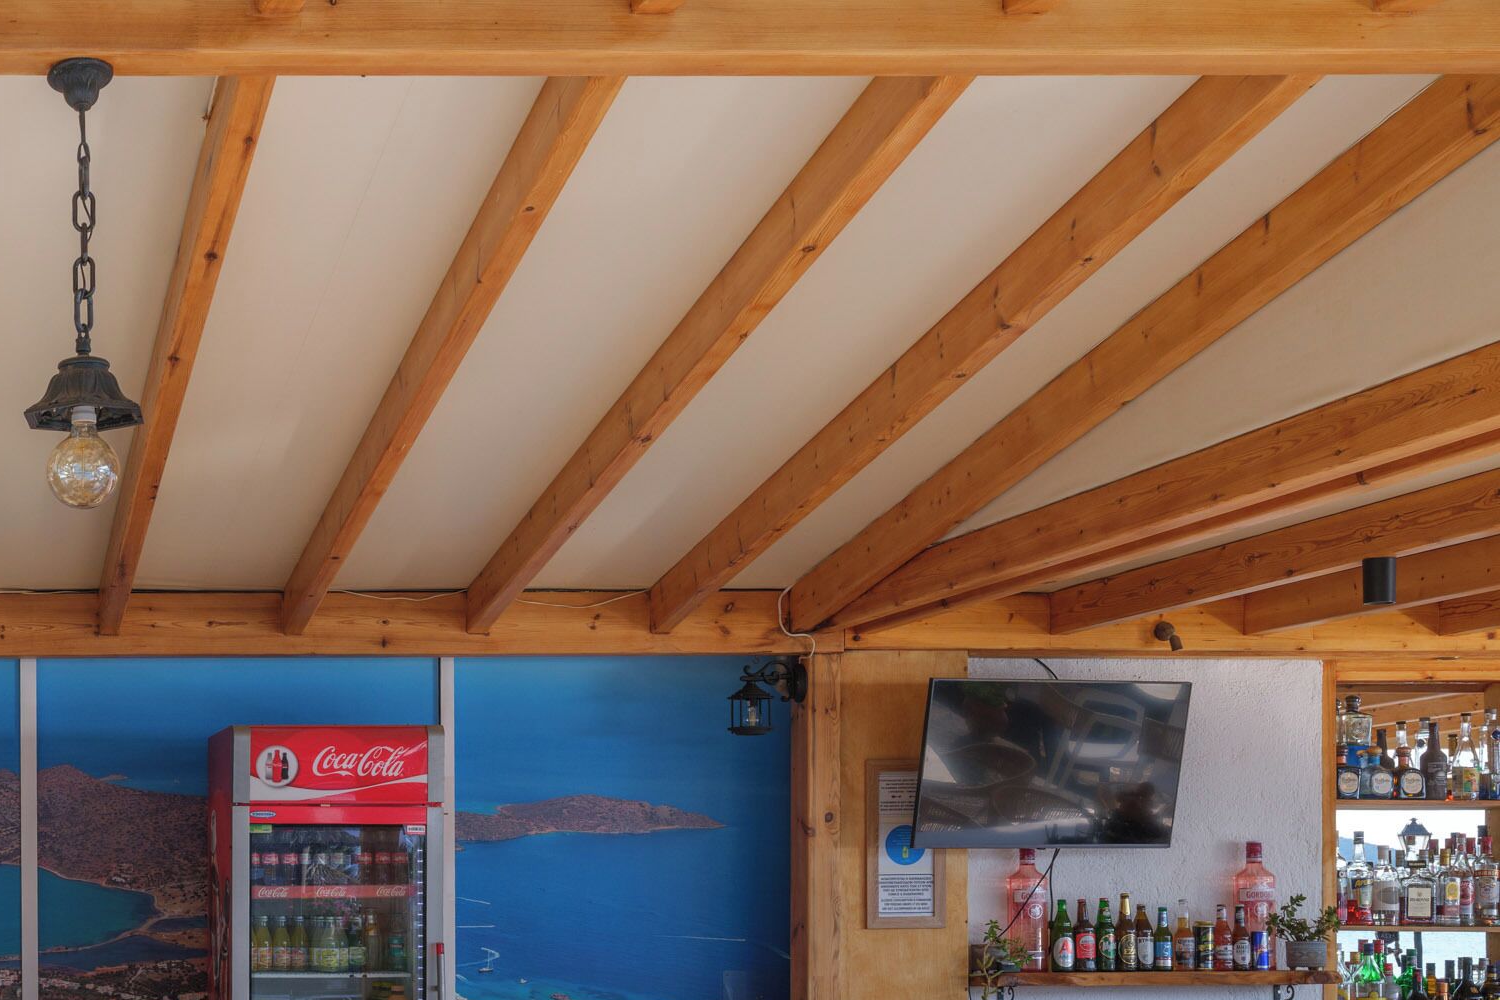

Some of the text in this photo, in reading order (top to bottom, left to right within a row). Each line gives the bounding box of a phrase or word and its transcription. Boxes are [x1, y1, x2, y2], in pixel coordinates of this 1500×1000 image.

[312, 744, 408, 778] Coca-Cola
[258, 887, 289, 898] Coca-Cola
[316, 886, 346, 898] Coca-Cola
[376, 886, 406, 897] Coca-Cola
